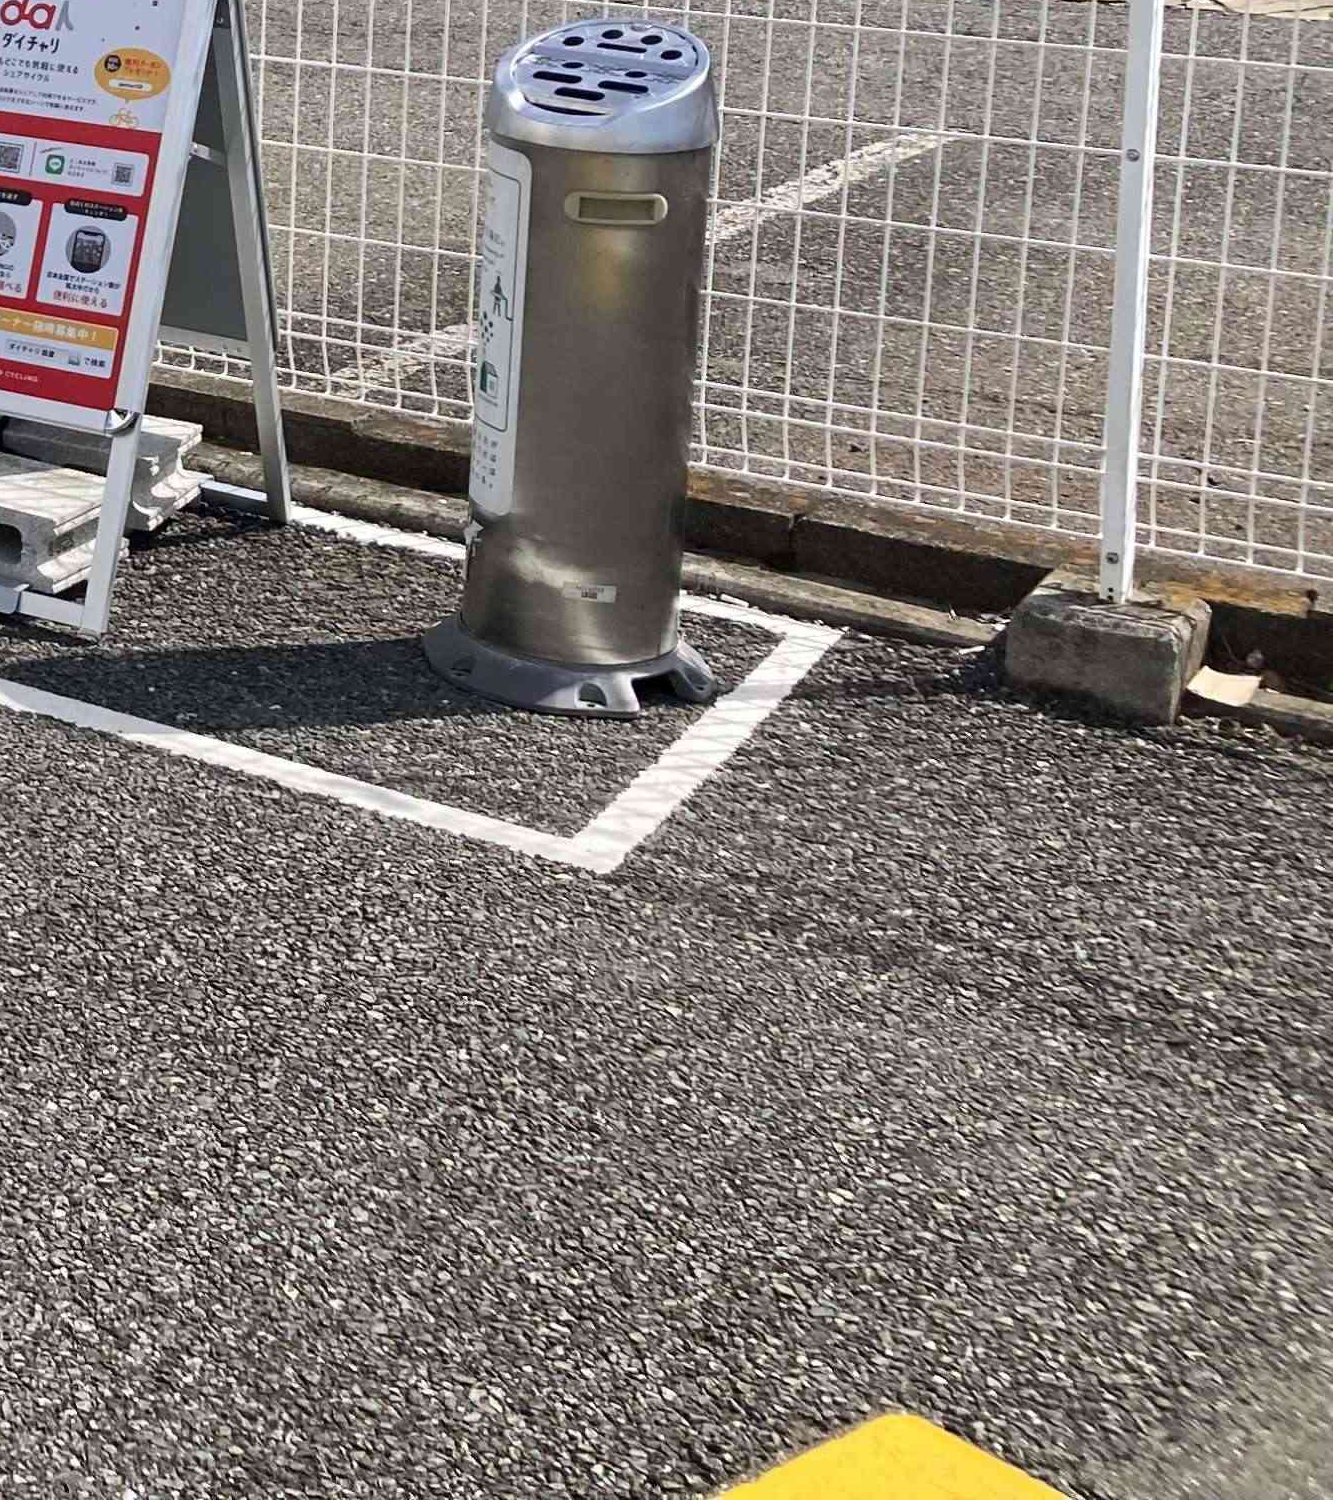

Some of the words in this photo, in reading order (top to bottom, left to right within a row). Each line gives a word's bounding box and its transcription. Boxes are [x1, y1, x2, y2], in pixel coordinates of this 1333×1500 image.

[2, 32, 61, 54] ダイチャリ
[2, 70, 50, 83] シェアサイクル
[52, 289, 108, 309] 便利に使える
